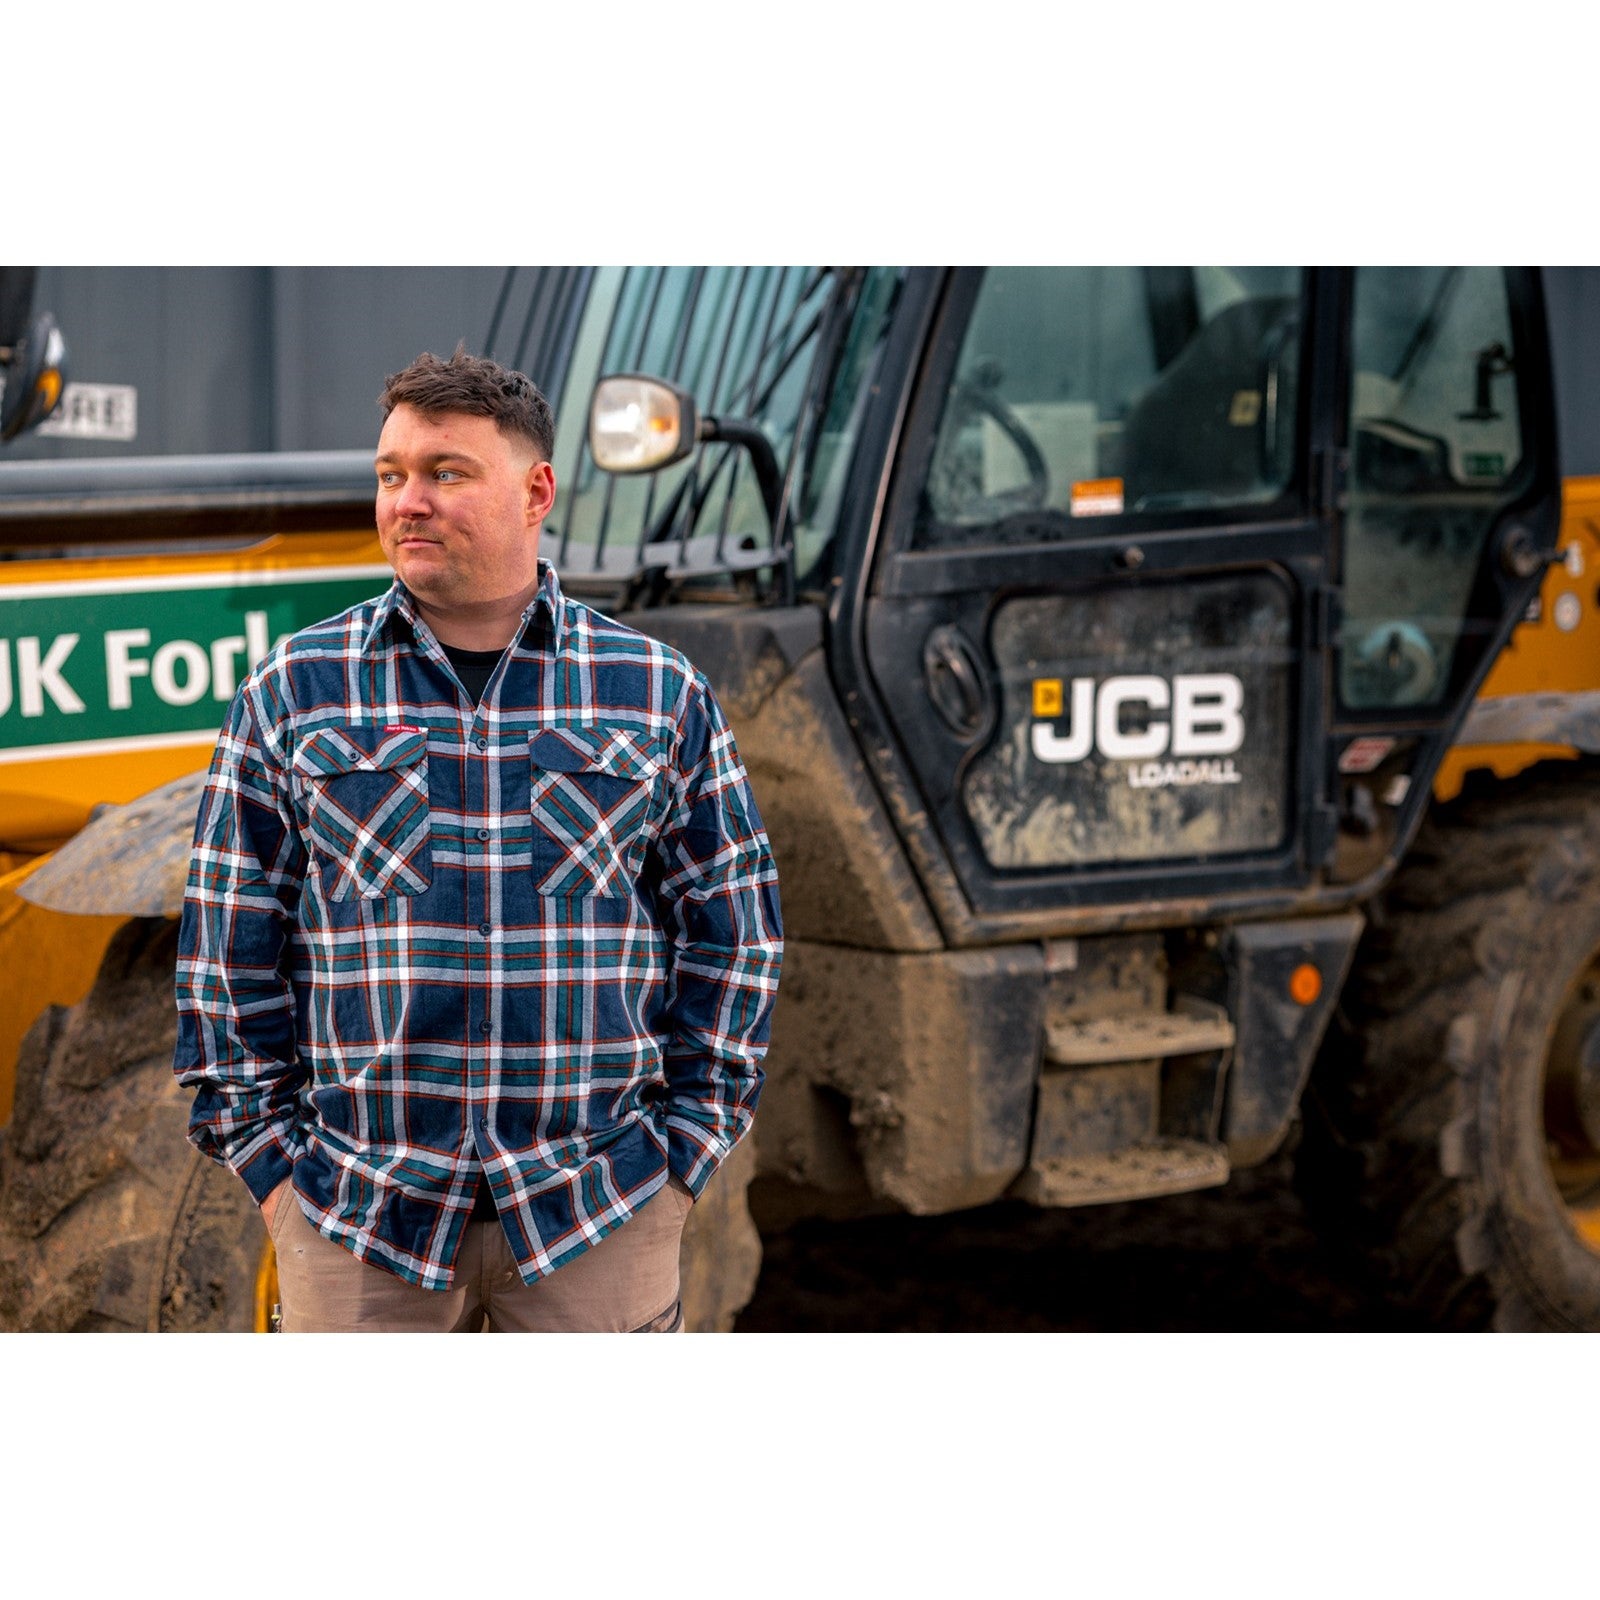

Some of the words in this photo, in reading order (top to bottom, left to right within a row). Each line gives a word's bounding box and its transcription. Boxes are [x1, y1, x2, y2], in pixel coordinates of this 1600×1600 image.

[0, 633, 87, 718] K
[1031, 672, 1245, 763] JCB
[1128, 759, 1242, 788] LOADALL
